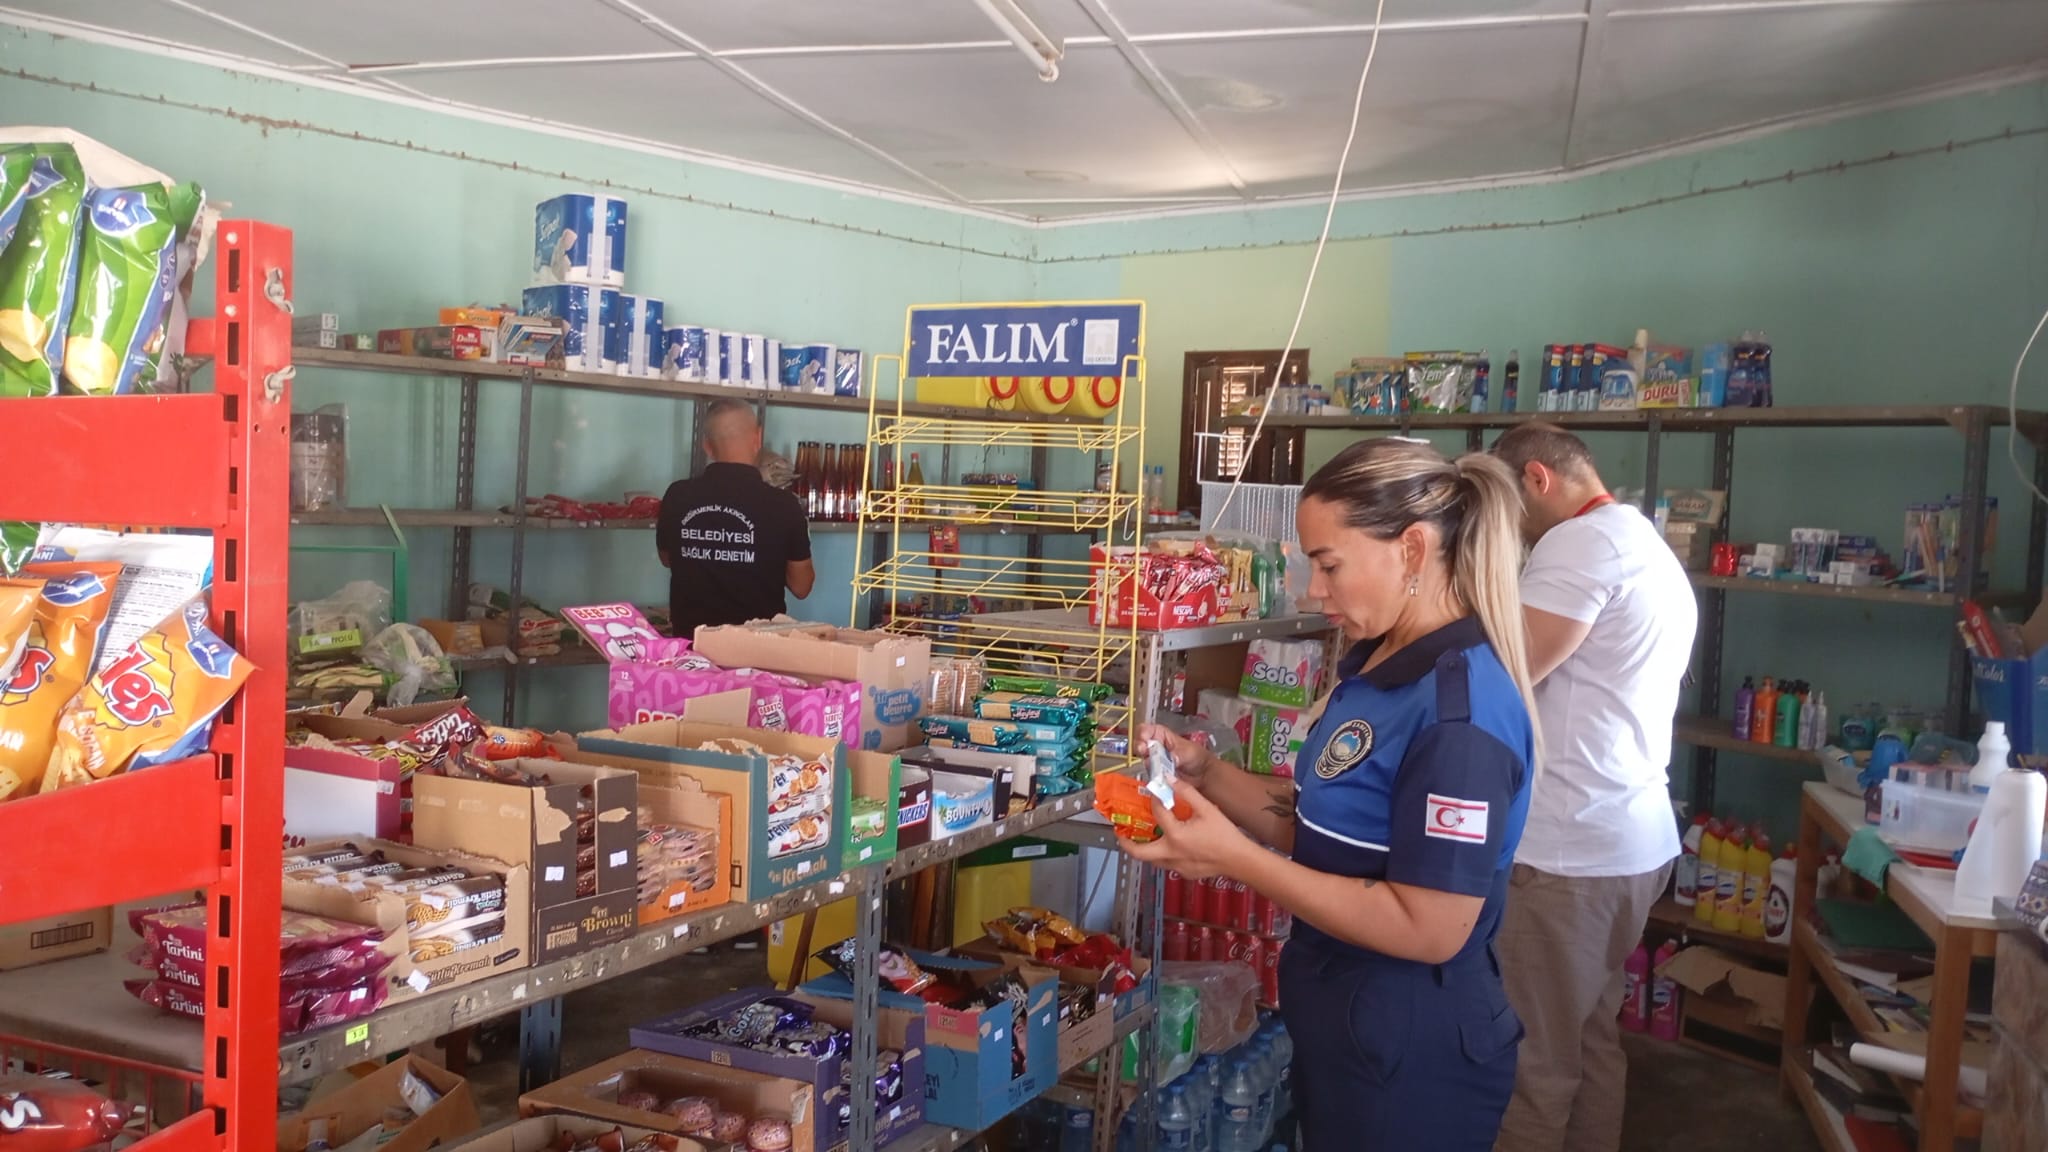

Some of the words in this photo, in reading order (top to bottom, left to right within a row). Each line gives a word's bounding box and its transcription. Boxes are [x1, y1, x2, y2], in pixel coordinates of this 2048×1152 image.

[926, 321, 1070, 364] FALIM
[1643, 383, 1679, 401] DURU
[680, 528, 755, 545] BELEDİYESİ
[680, 546, 712, 560] SAĞLIK
[714, 549, 756, 563] DENETİM
[574, 605, 629, 619] BEBTO
[415, 712, 471, 744] Tutku
[945, 801, 983, 825] BOUNTY
[581, 907, 632, 934] Browni
[162, 940, 205, 962] Tartini
[452, 954, 491, 977] Kremalı
